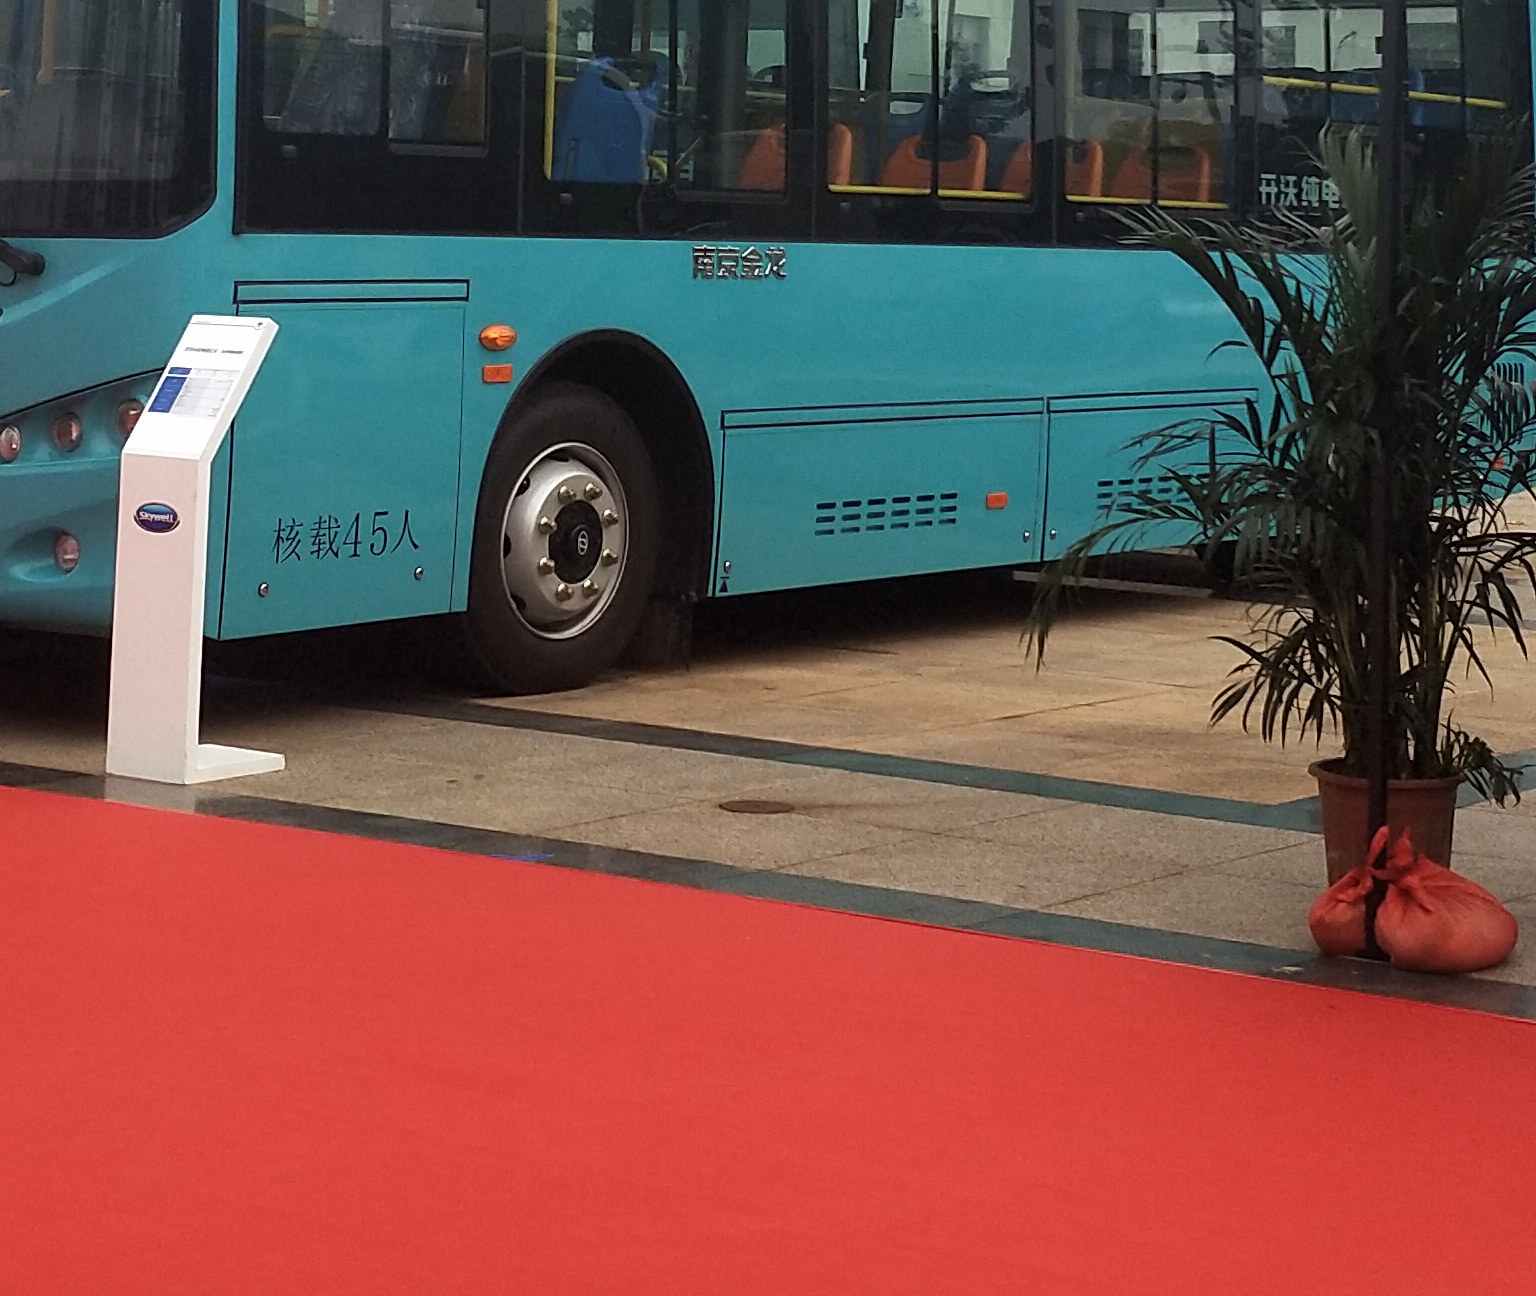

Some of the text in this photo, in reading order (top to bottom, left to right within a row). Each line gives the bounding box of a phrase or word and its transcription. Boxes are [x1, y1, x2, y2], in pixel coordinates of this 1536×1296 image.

[692, 244, 787, 279] 南京金龙
[271, 508, 419, 564] 核载45人
